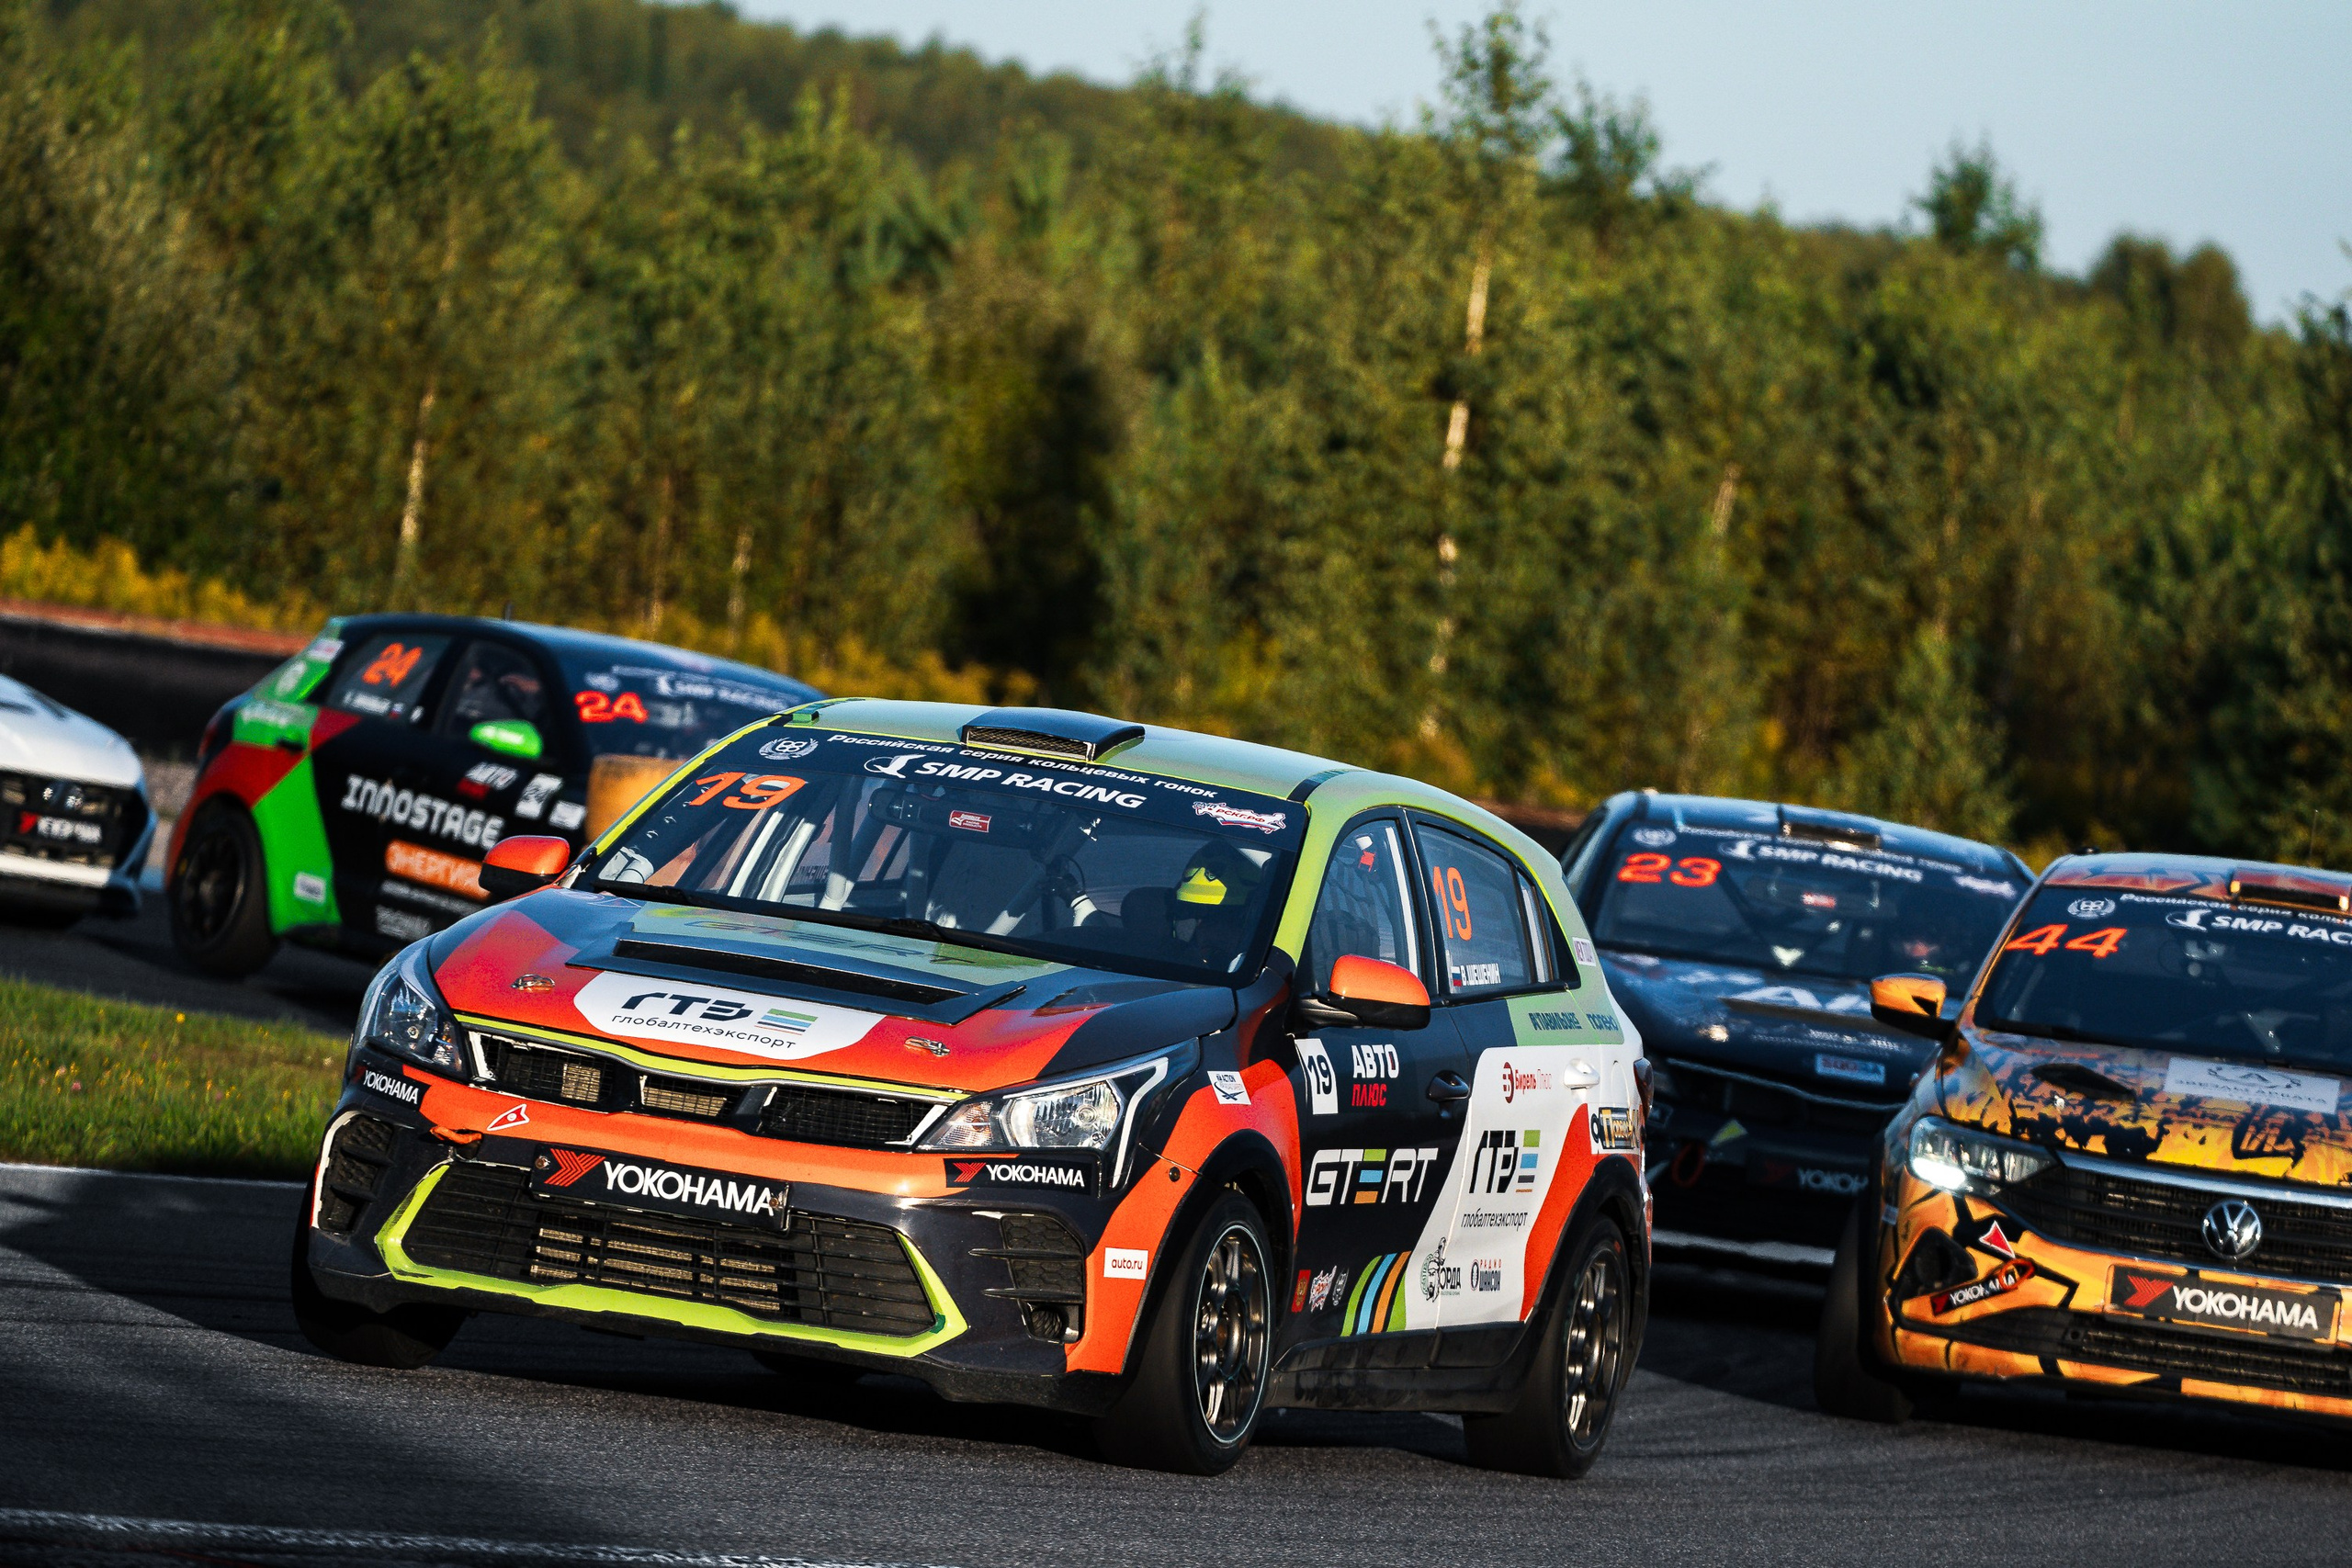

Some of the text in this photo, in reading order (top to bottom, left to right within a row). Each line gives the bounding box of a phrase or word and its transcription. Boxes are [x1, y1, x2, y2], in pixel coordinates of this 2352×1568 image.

[362, 643, 424, 687] 24
[573, 690, 650, 723] 24
[827, 734, 1218, 798] Российская серия кольцевых гонок
[915, 761, 1148, 808] SMP RACING
[689, 772, 806, 809] 19
[1618, 852, 1724, 887] 23
[1758, 845, 1819, 863] SMP
[1820, 852, 1924, 883] RACING
[1433, 865, 1472, 941] 19
[2006, 923, 2129, 959] 44
[2211, 915, 2352, 945] SMP RAC
[611, 1013, 797, 1050] глобалтехэкспорт
[1307, 1054, 1332, 1094] 19
[1351, 1043, 1399, 1078] АВТО
[363, 1069, 420, 1106] YOKOHAMA
[1351, 1083, 1387, 1107] ПЛЮС
[604, 1160, 775, 1217] YOKOHAMA
[986, 1164, 1085, 1188] YOKOHAMA
[1306, 1147, 1439, 1205] GTERT
[1461, 1207, 1528, 1230] глобалтехэкспорт
[1111, 1257, 1143, 1272] auto.ru
[1480, 1258, 1502, 1269] РАДИО
[2173, 1285, 2320, 1331] YOKOHAMA
